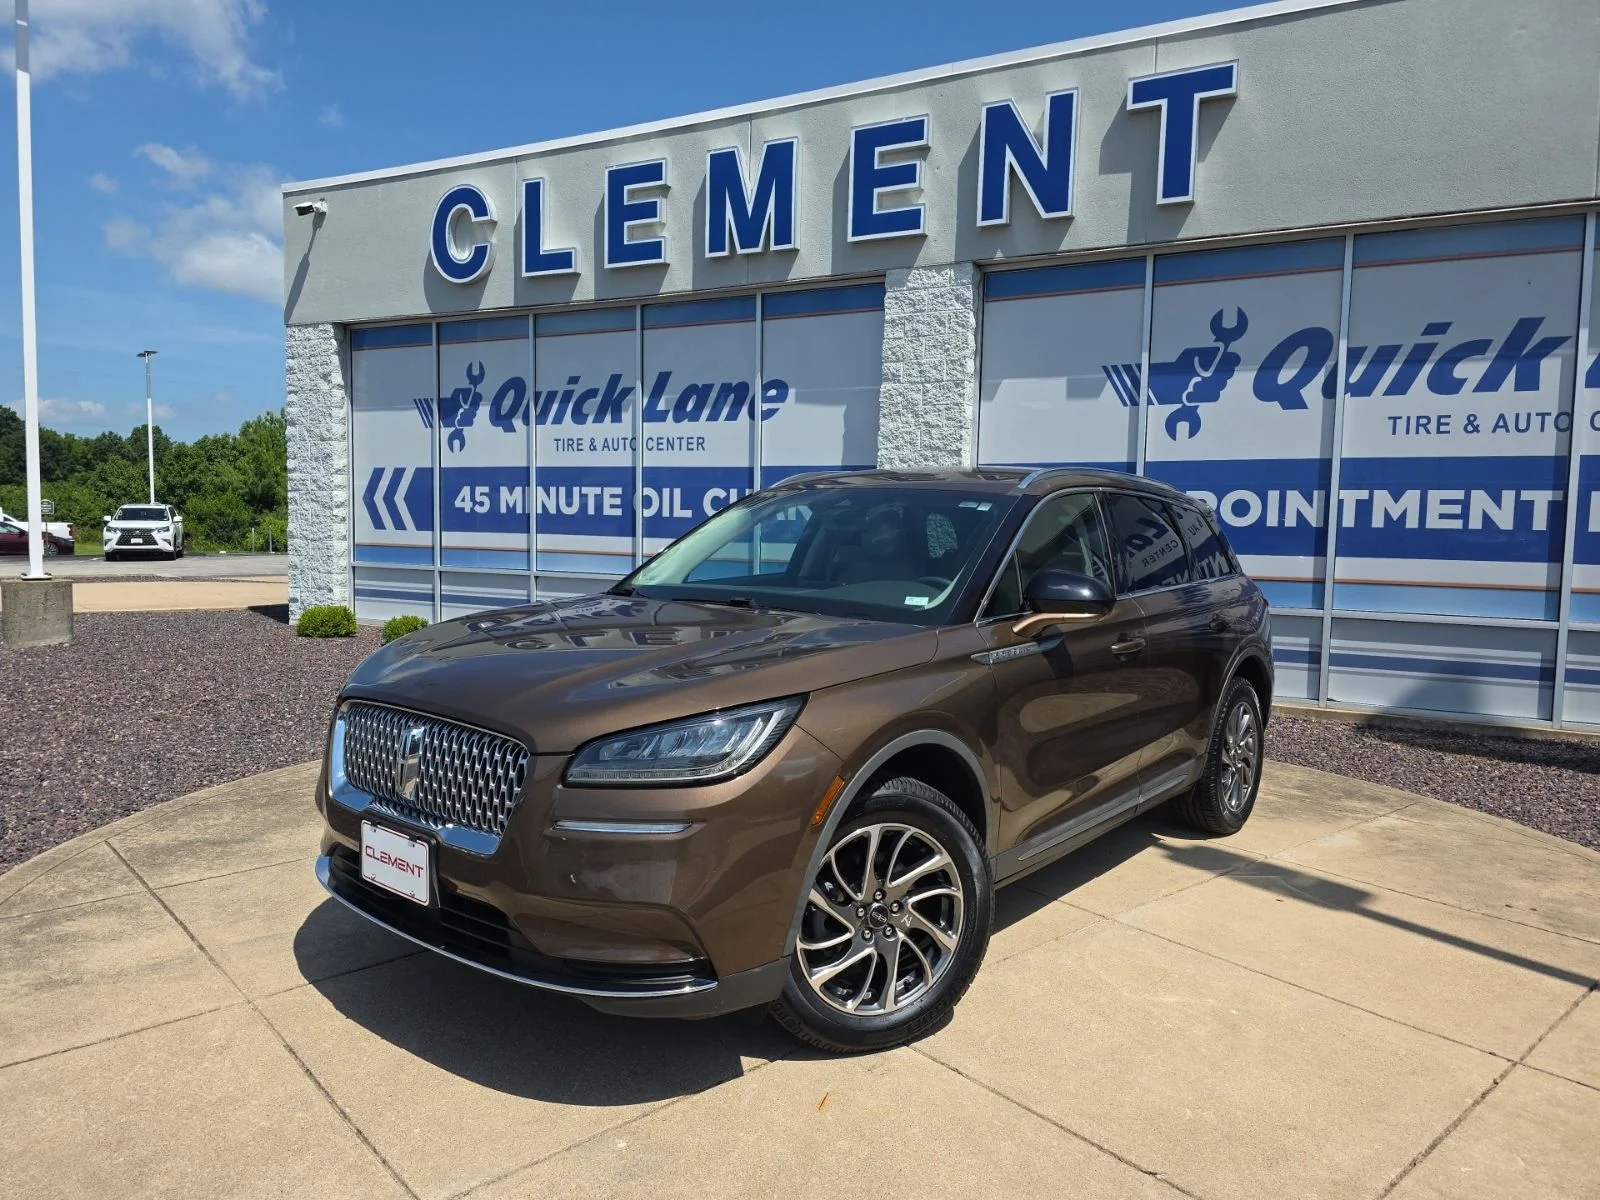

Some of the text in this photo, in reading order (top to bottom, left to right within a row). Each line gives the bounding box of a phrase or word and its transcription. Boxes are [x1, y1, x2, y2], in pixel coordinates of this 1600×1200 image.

[429, 58, 1239, 285] CLEMENT
[1252, 316, 1573, 411] Quick
[488, 370, 790, 433] Quick Lane
[1387, 414, 1452, 436] TIRE
[1462, 413, 1481, 435] &
[1491, 411, 1572, 434] AUTO
[553, 436, 706, 452] TIRE & AUTO CENTER
[454, 485, 490, 513] 45
[499, 486, 623, 517] MINUTE
[633, 487, 693, 518] OIL
[365, 844, 424, 878] CLEMENT
